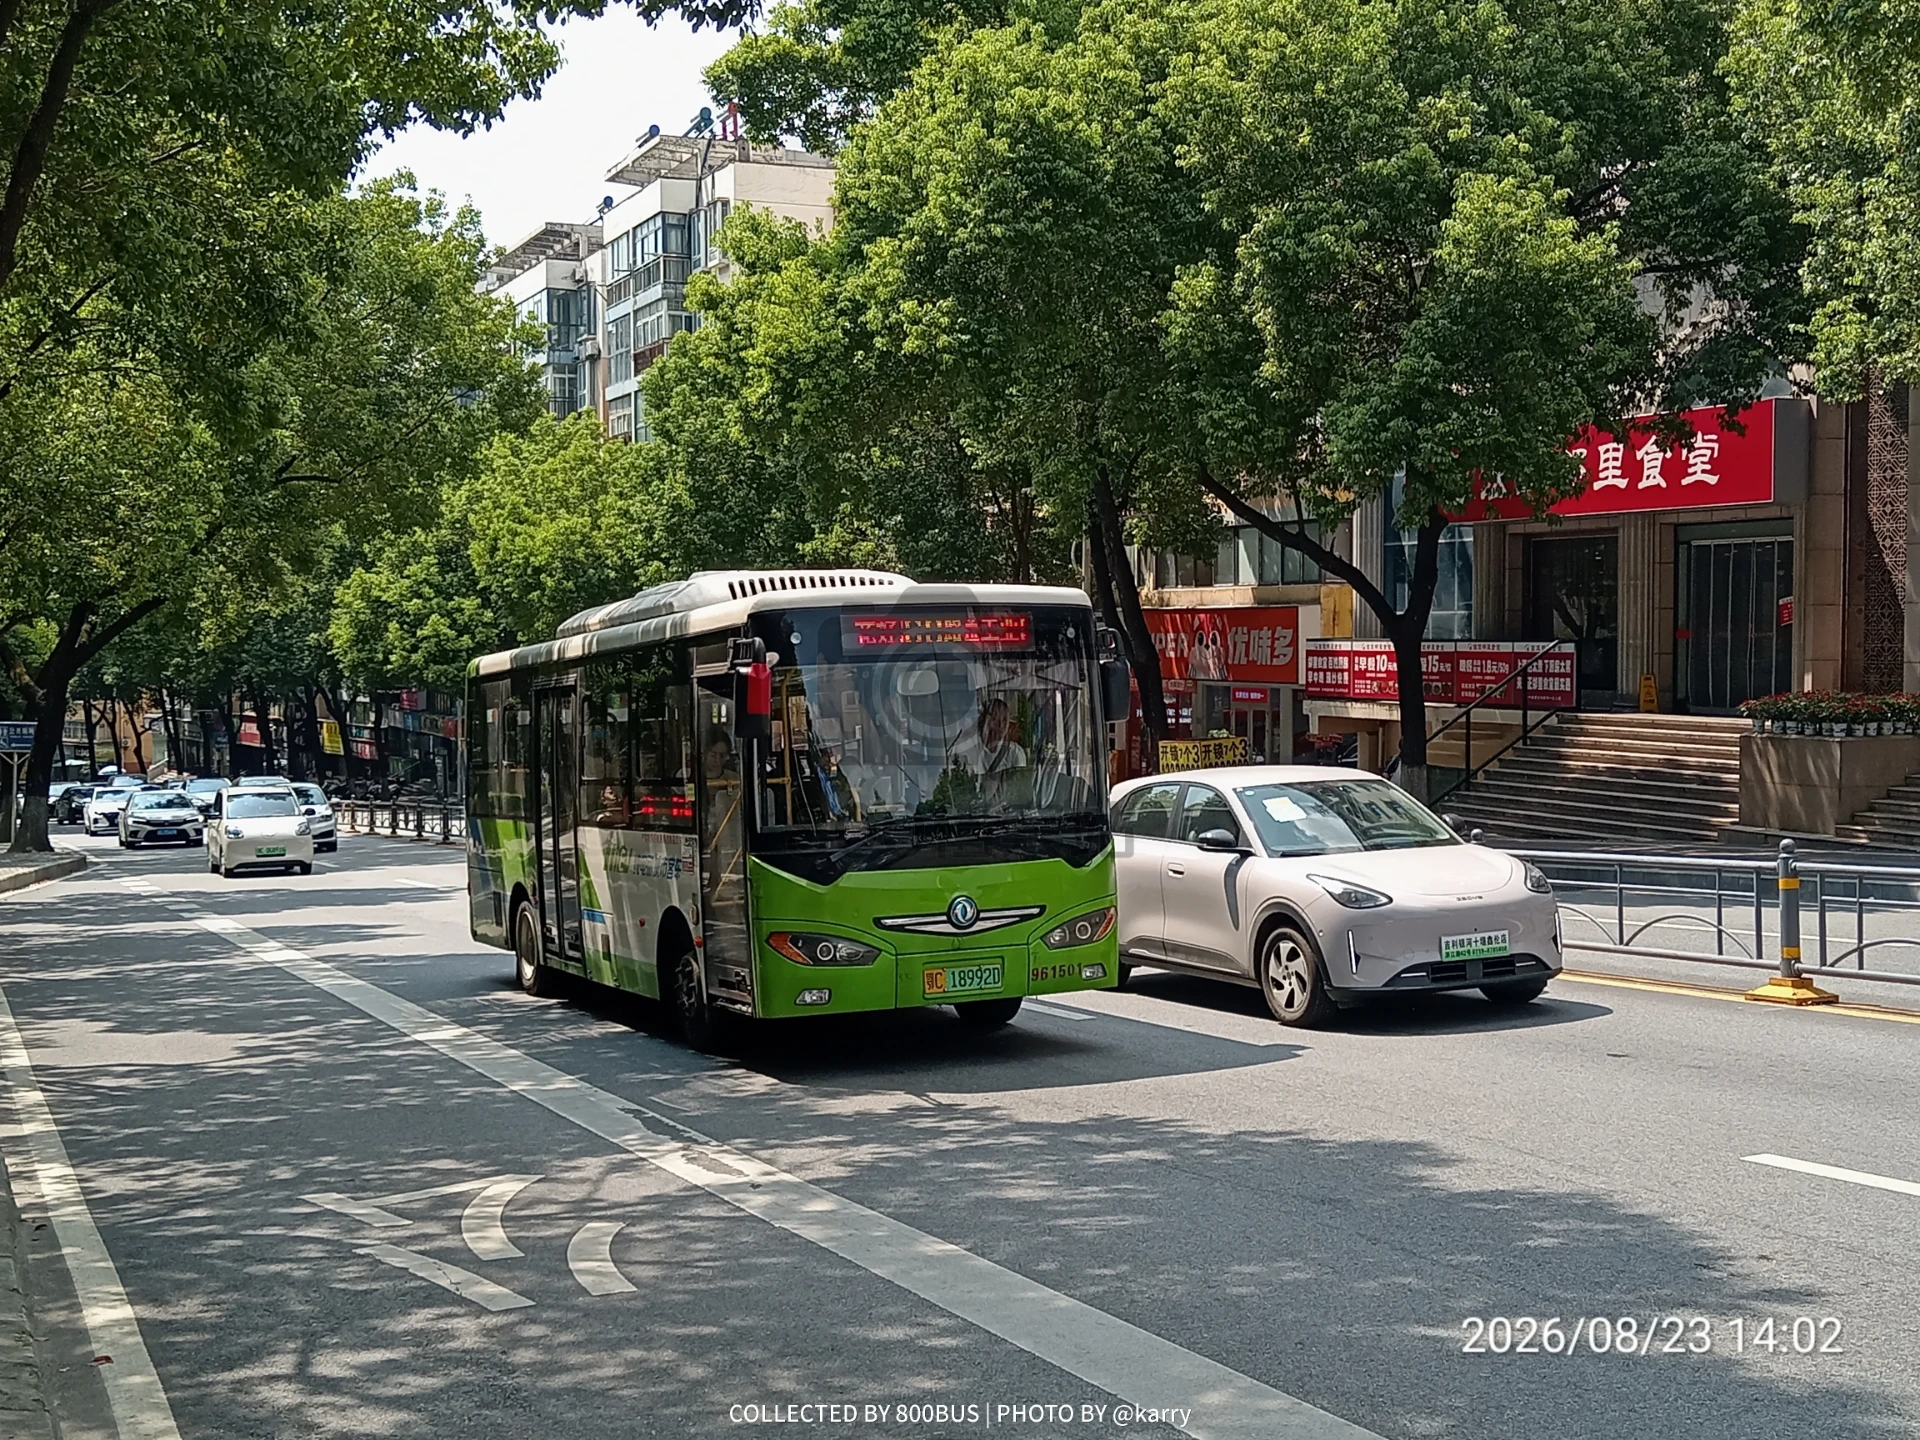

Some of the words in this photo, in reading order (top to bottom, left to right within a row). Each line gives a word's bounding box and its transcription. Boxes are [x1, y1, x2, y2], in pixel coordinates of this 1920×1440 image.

[1228, 626, 1294, 666] 优味多
[950, 966, 1001, 989] 18992D
[1031, 963, 1082, 982] 961501
